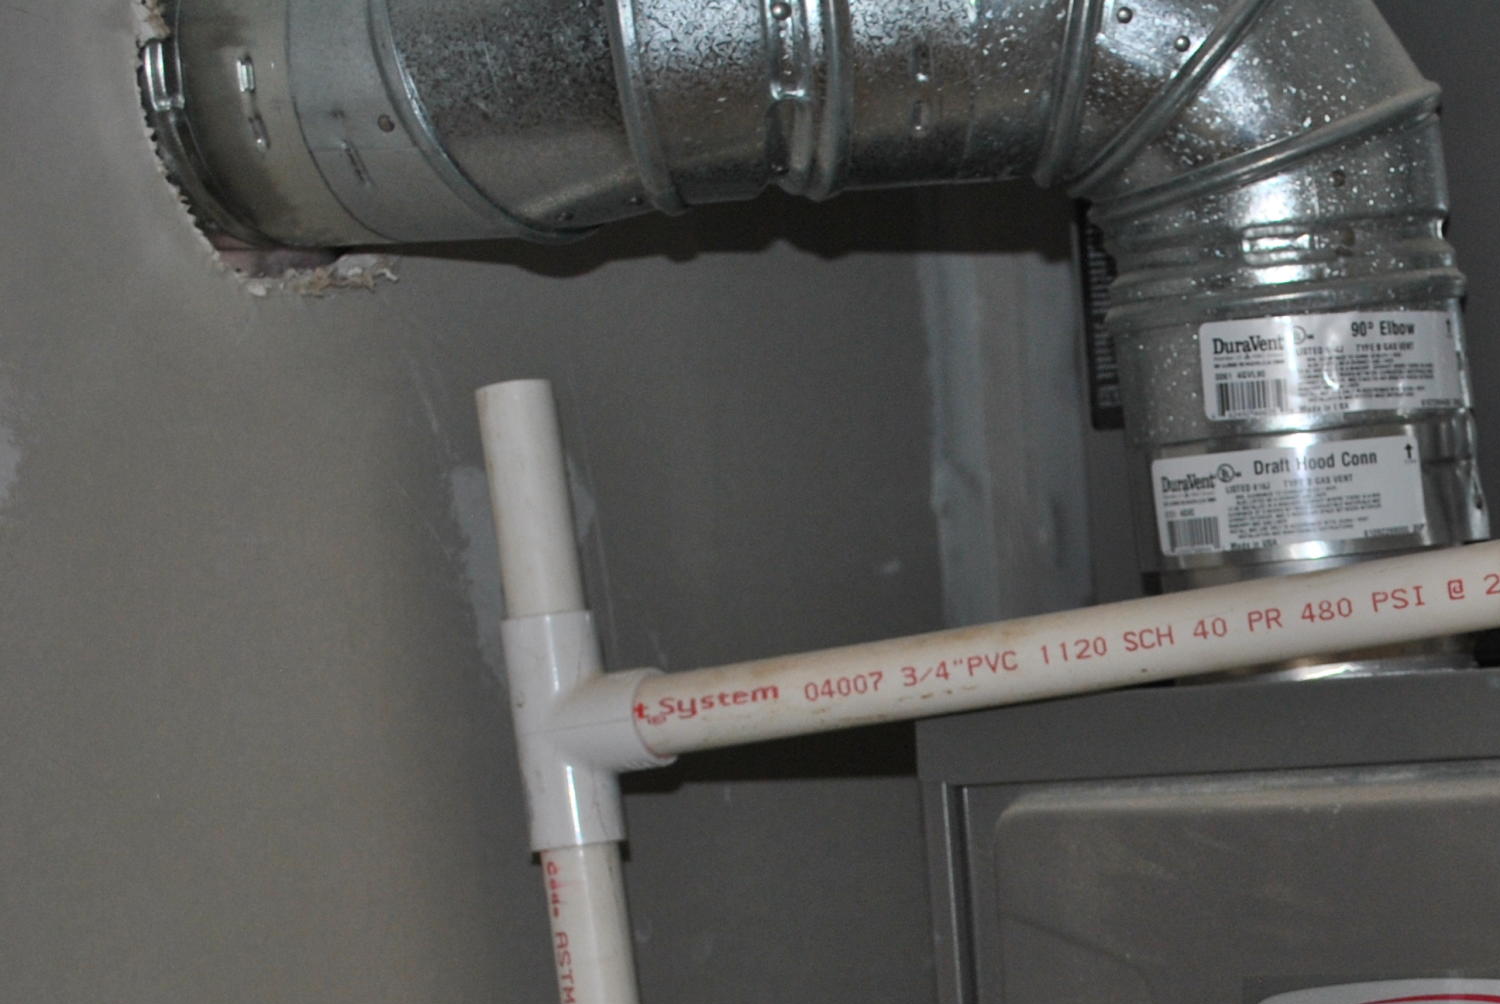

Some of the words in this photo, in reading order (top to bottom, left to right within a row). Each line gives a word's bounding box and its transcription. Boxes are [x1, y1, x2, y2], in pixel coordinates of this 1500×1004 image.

[1380, 320, 1415, 336] Elbow
[1212, 334, 1284, 355] DuraVent
[1254, 458, 1290, 475] Draft
[1297, 454, 1335, 470] Hood
[1341, 451, 1377, 467] Conn
[1161, 473, 1216, 493] DuraVent
[659, 685, 780, 720] System
[804, 671, 883, 702] 04007
[1041, 636, 1108, 665] 1120
[1123, 625, 1175, 653] SCH
[1193, 616, 1229, 641] 40
[1247, 608, 1283, 633] PR
[1301, 597, 1353, 624] 480
[1371, 585, 1426, 613] PSI
[1447, 578, 1466, 600] @
[555, 931, 577, 1004] ASTM
